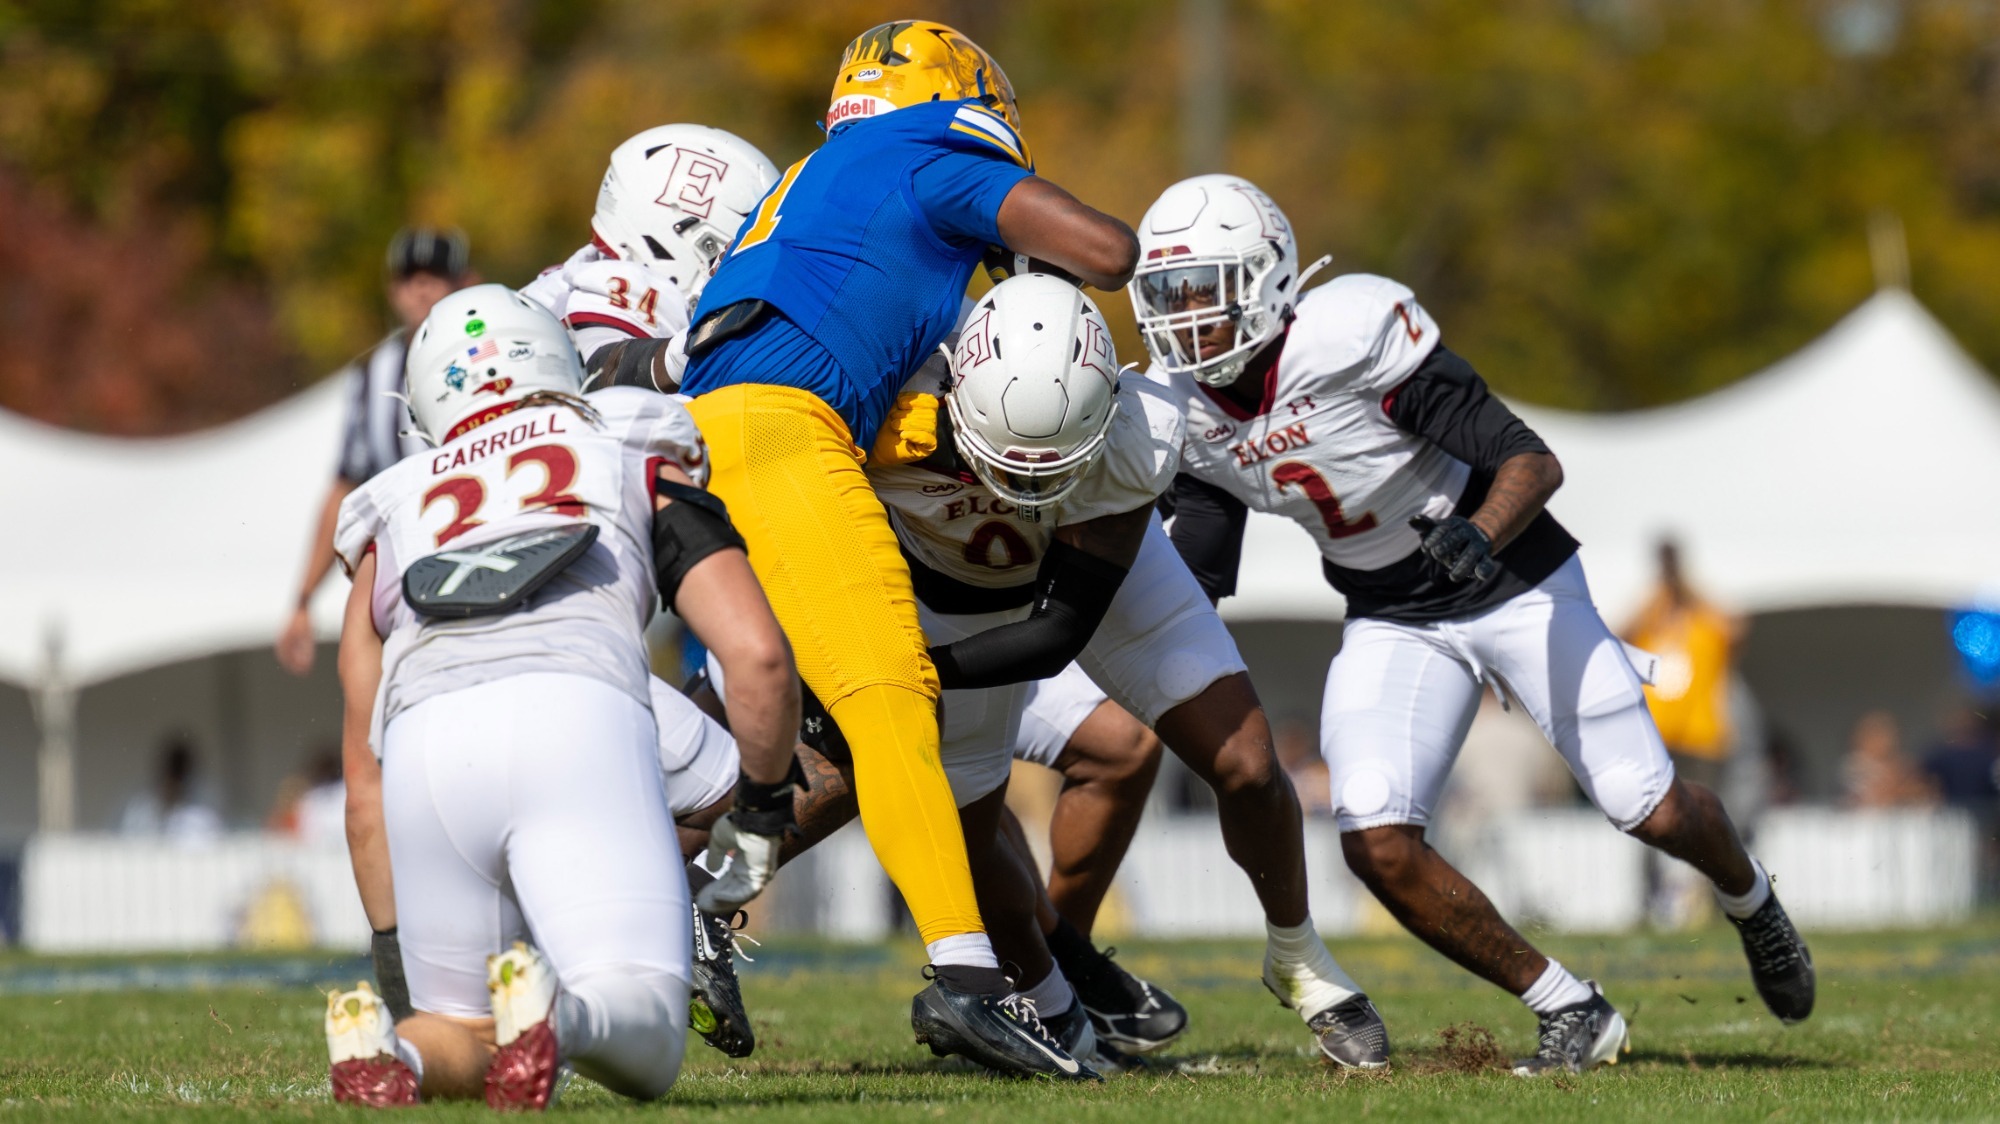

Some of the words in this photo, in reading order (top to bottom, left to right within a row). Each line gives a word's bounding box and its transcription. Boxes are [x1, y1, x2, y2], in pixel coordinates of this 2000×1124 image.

[655, 147, 729, 219] E
[731, 150, 818, 257] 1
[607, 276, 660, 329] 34
[1393, 302, 1423, 346] 2
[432, 413, 566, 475] CARROLL
[1204, 423, 1231, 440] CAA
[1231, 422, 1311, 467] ELON
[922, 483, 957, 494] CAA
[1271, 459, 1379, 539] 2
